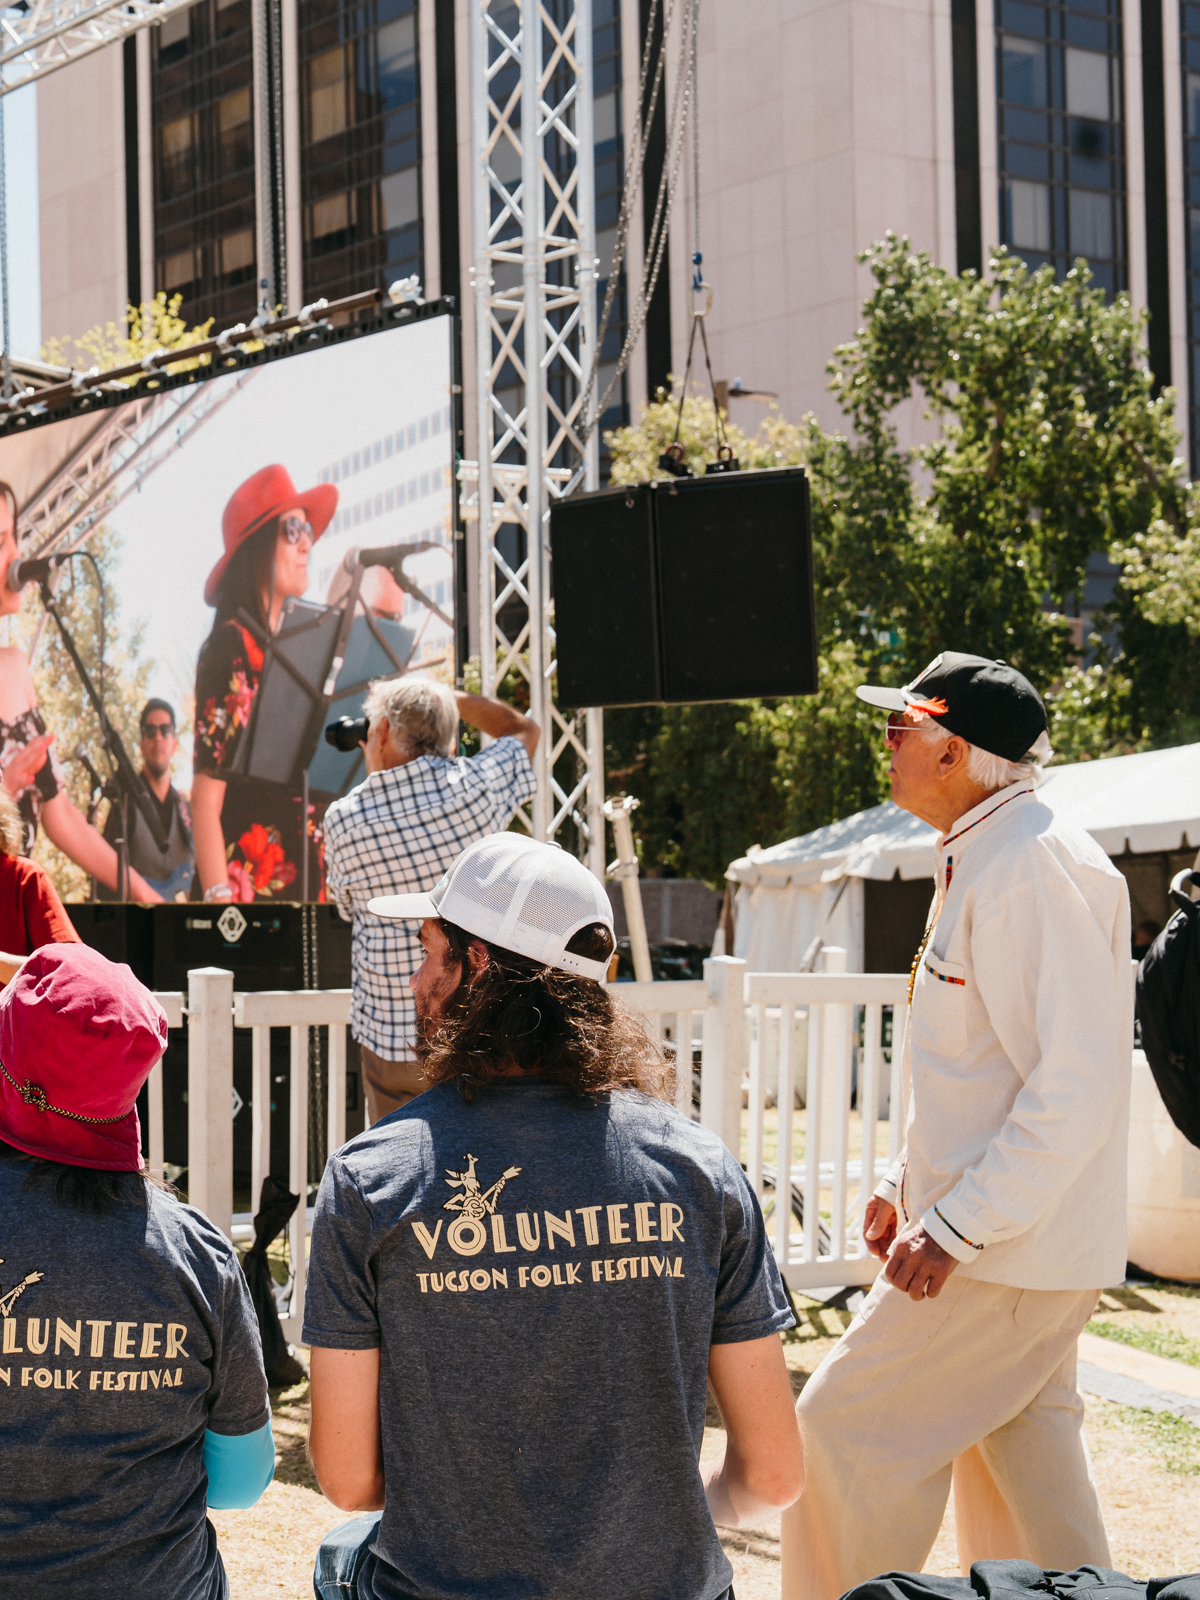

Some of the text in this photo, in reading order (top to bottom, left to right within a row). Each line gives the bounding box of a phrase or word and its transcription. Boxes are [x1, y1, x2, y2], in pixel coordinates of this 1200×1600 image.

[411, 1202, 685, 1260] VOLUNTEER
[416, 1256, 685, 1293] TUCSON FOLK FESTIVAL
[21, 1367, 81, 1389] FOLK
[90, 1368, 183, 1391] FESTIVAL
